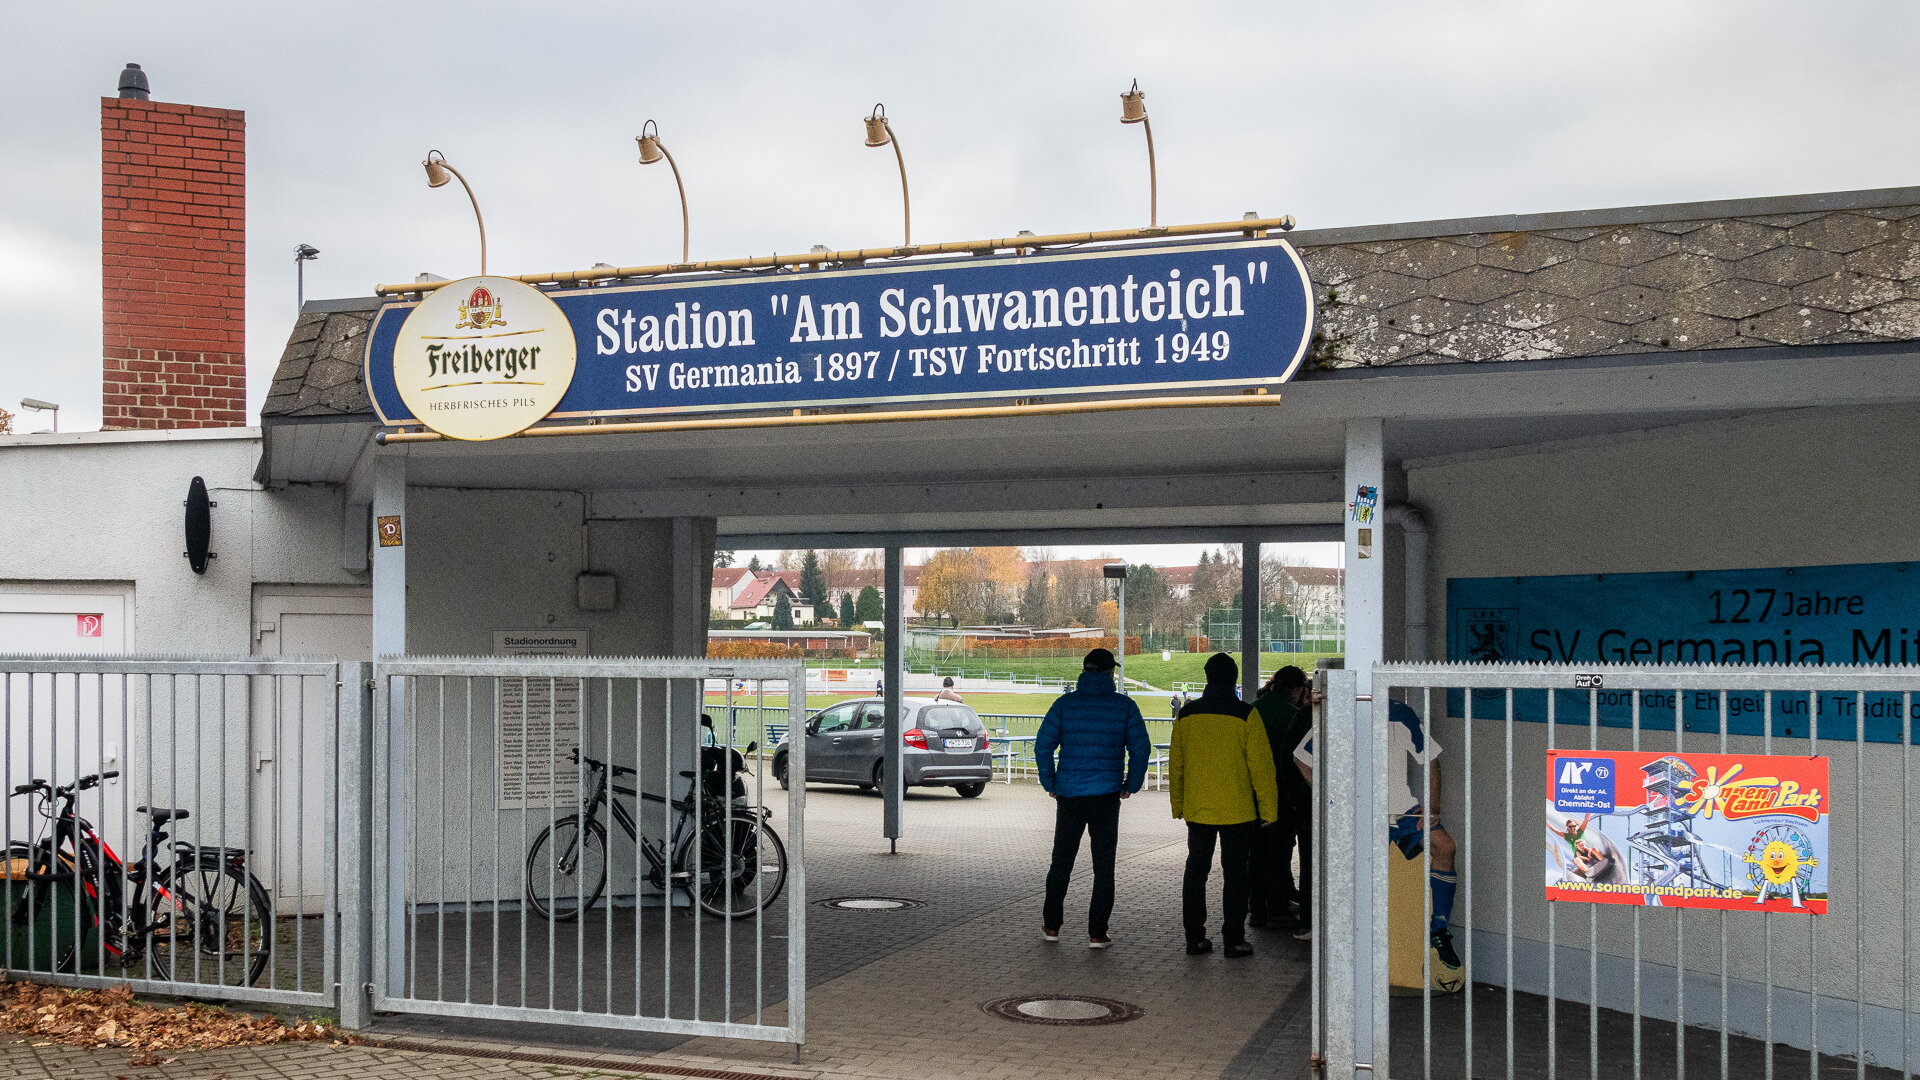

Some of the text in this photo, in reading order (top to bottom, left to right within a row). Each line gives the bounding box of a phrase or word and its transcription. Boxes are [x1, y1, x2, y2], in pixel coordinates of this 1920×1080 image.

[596, 261, 1268, 356] Stadion "Am Schwanenteich"
[426, 343, 541, 379] Freiberger
[625, 364, 659, 393] SV
[668, 356, 802, 391] Germania
[813, 350, 882, 383] 1897
[909, 346, 968, 377] TSV
[977, 336, 1141, 374] Fortschritt
[1154, 330, 1231, 365] 1949
[429, 397, 536, 411] HERBFRISCHES PILS
[1708, 588, 1864, 624] 127 Jahre
[504, 637, 577, 647] Stadionordnung
[1528, 629, 1581, 666] SV
[1598, 629, 1824, 667] Germania
[1558, 800, 1611, 808] Chemnitz-Ost
[1774, 781, 1822, 807] Park
[1557, 880, 1743, 900] www.sonnenlandpark.de
